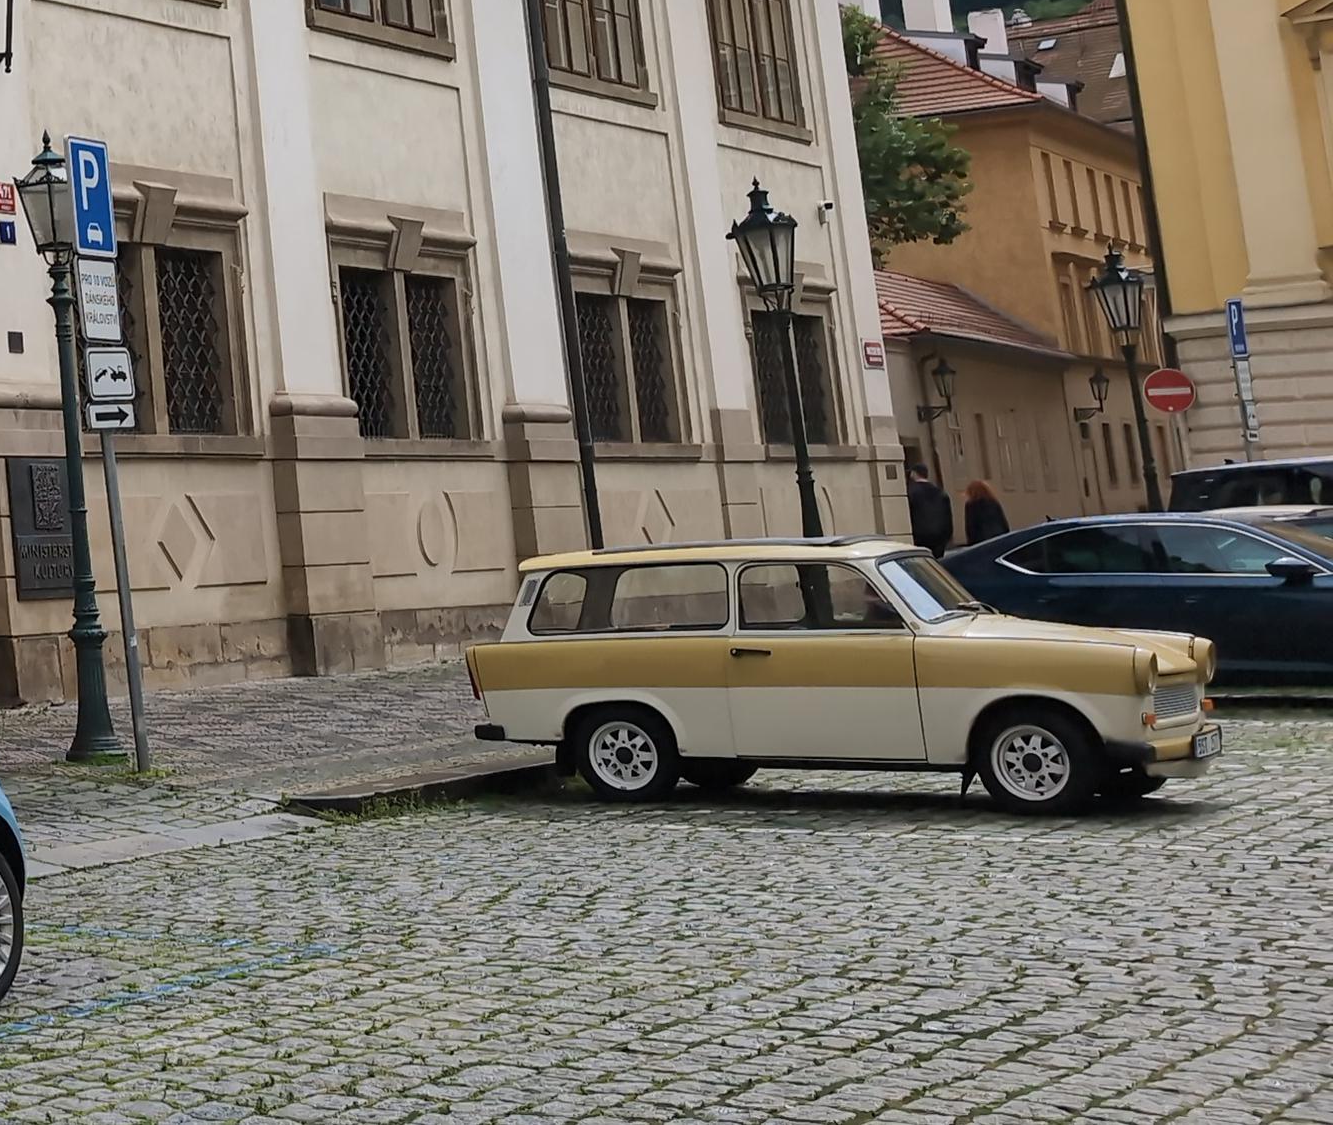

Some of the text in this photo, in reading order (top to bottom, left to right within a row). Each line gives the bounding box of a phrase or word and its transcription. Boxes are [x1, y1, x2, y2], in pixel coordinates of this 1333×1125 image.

[78, 150, 99, 210] P
[1231, 304, 1238, 336] P
[20, 544, 73, 558] MINISTERST
